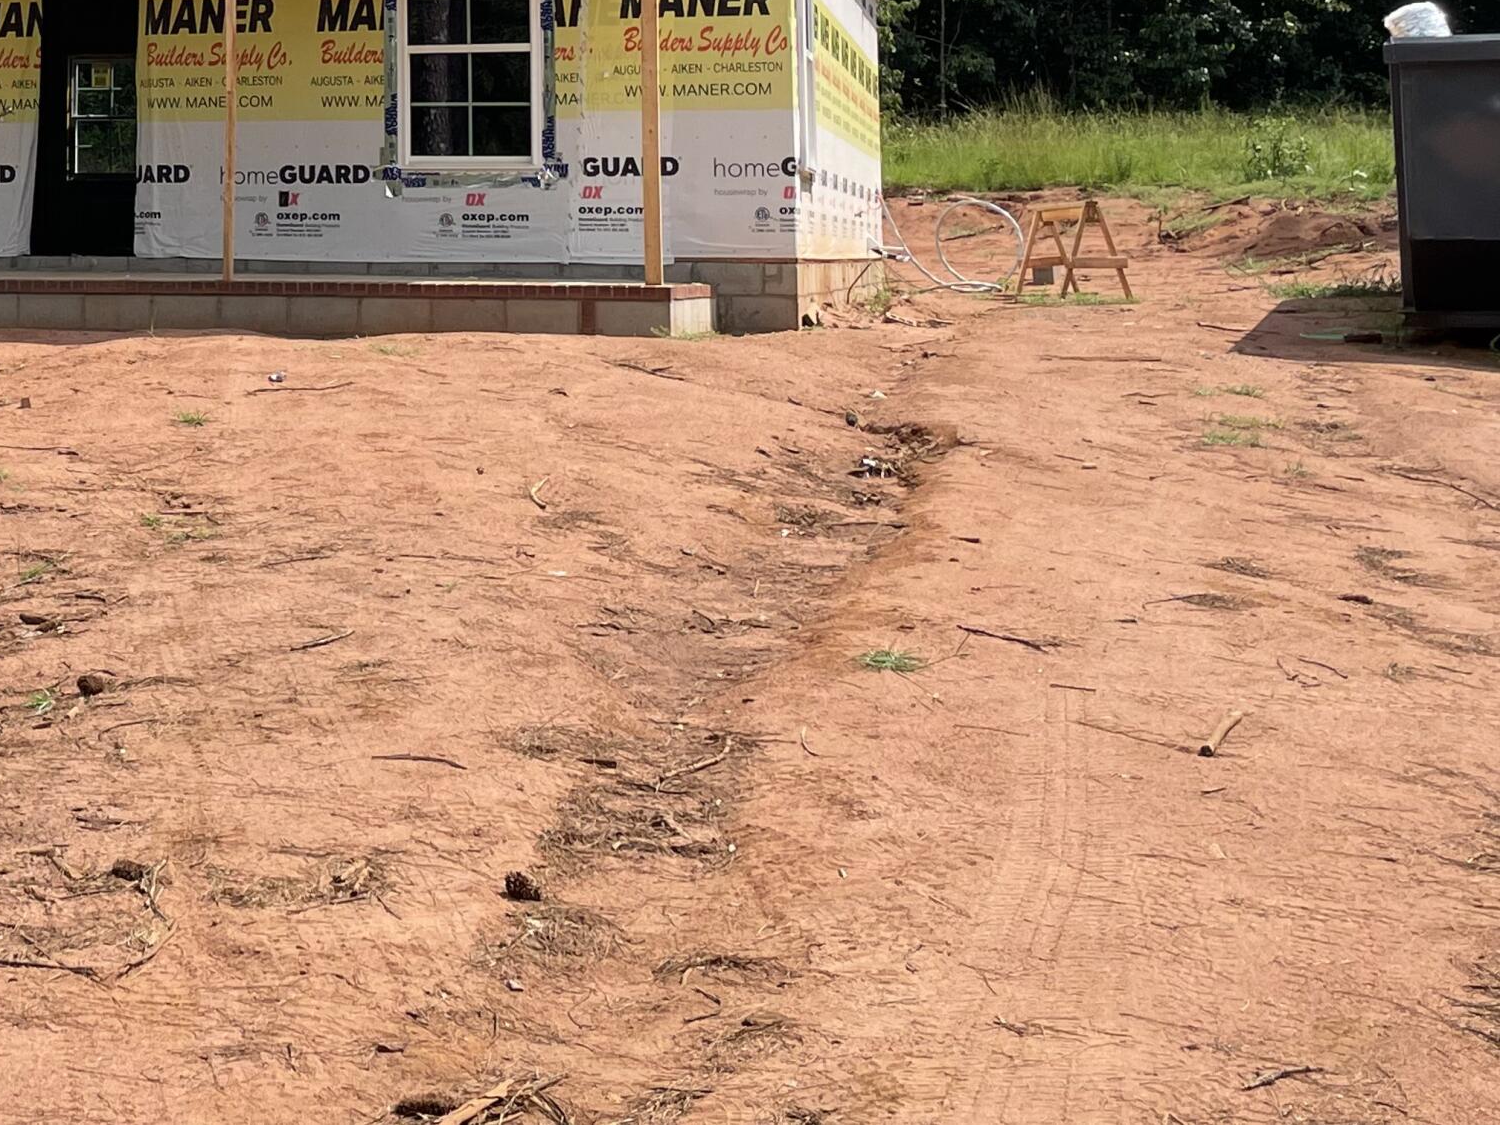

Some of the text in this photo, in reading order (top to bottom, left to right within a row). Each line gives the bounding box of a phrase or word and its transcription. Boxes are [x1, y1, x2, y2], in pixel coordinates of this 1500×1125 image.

[698, 25, 761, 58] Supply
[147, 41, 293, 70] Builders Co.
[321, 39, 385, 65] Builders
[613, 61, 783, 76] AUGU AIKEN CHARLESTON
[11, 79, 37, 89] AIKEN
[185, 75, 283, 87] AIKEN CARLESTON
[311, 74, 385, 86] AUGUSTA AIKE
[672, 82, 772, 96] MANER.COM
[185, 95, 274, 108] MANE.COM
[583, 157, 679, 177] GUAD
[713, 157, 797, 178] homeG
[582, 186, 604, 199] OX
[465, 193, 486, 206] OX
[277, 212, 340, 222] oxep.com
[462, 212, 529, 223] oxep.com
